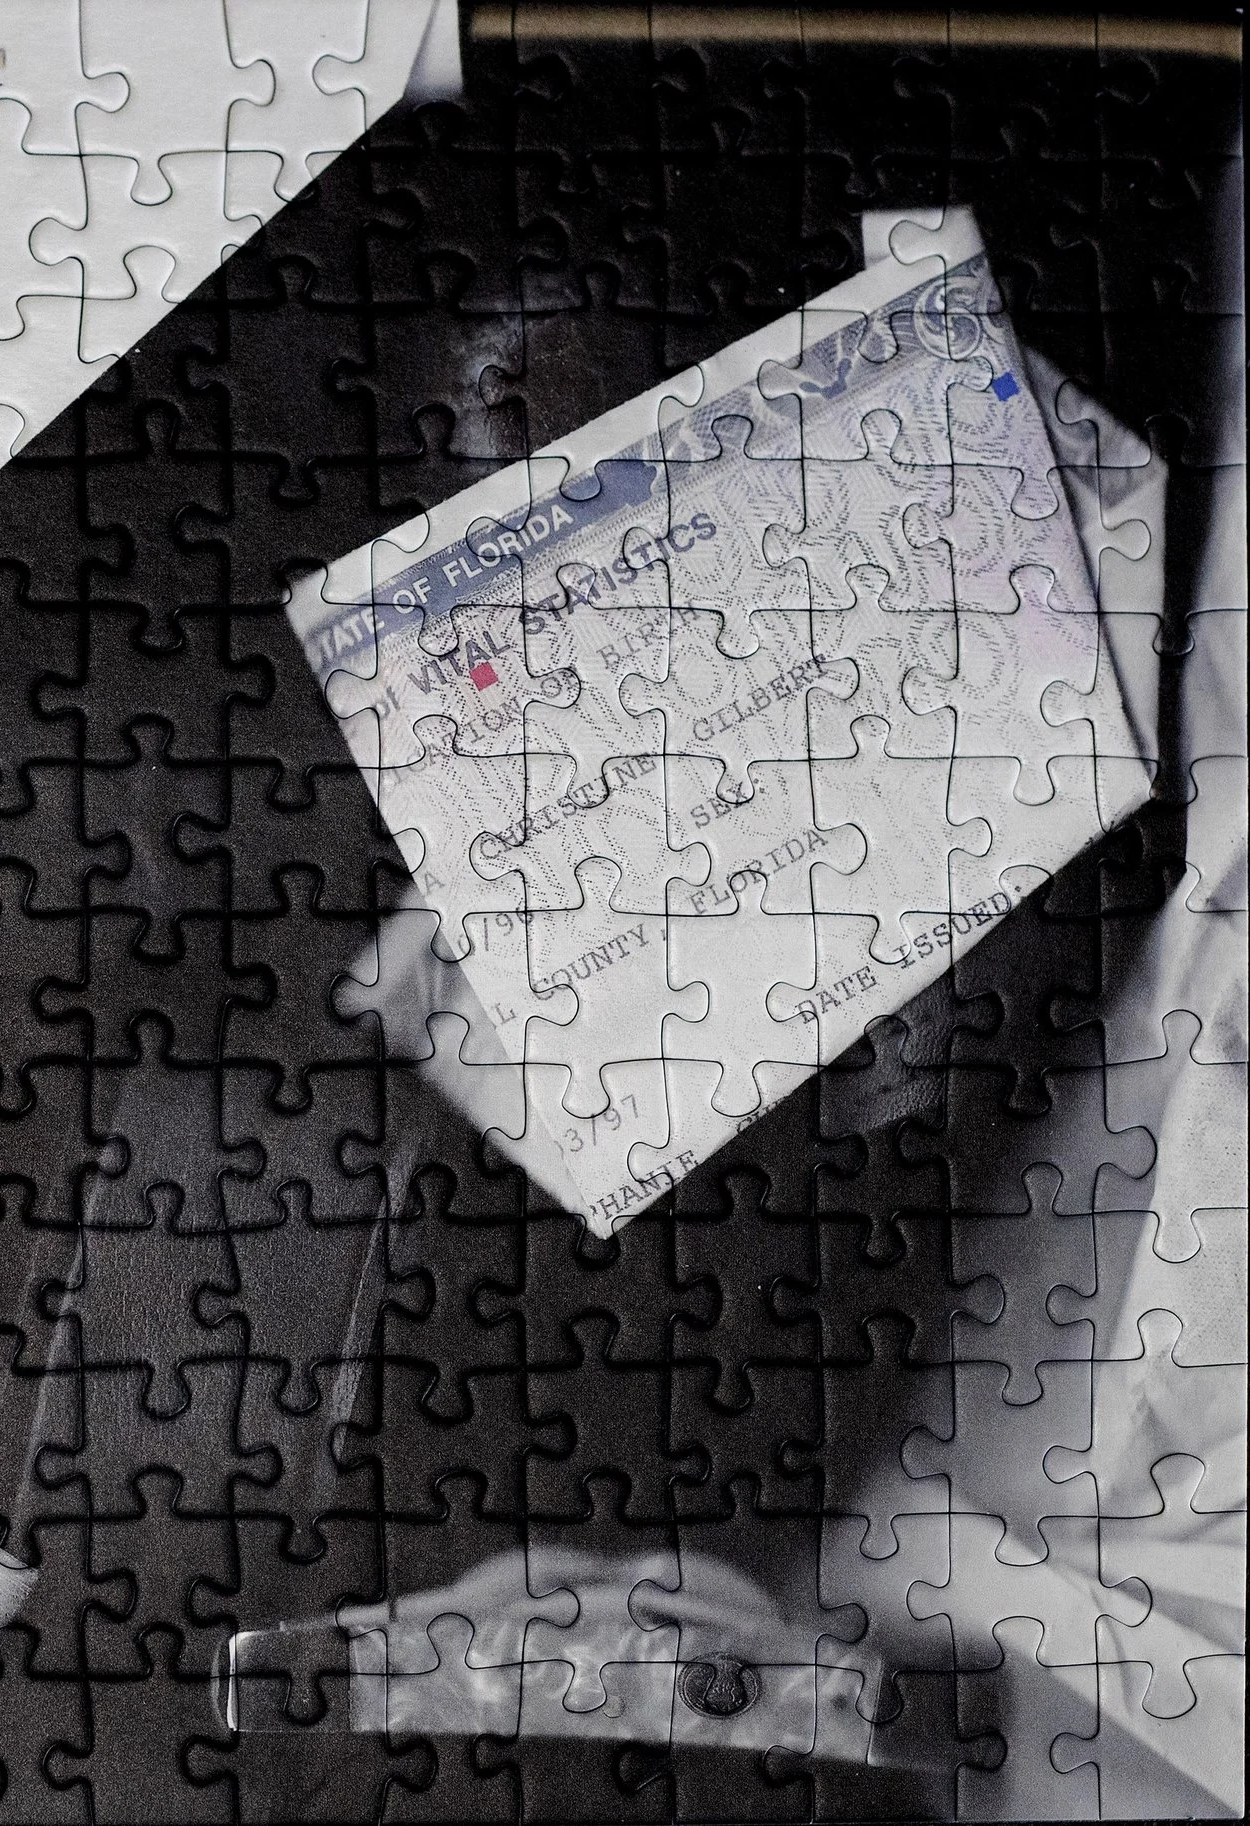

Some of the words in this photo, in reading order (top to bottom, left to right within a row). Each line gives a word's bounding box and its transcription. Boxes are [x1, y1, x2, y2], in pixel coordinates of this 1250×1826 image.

[392, 576, 432, 614] OF
[442, 503, 574, 587] FLORIDA
[407, 630, 511, 695] VITAL
[519, 512, 717, 635] STATISTICS
[423, 870, 446, 896] A
[479, 752, 657, 860] CHRISTINE
[693, 653, 827, 741] GILBERT
[493, 1002, 517, 1025] L
[689, 828, 828, 916] FLORIDA
[795, 965, 878, 1025] DATE
